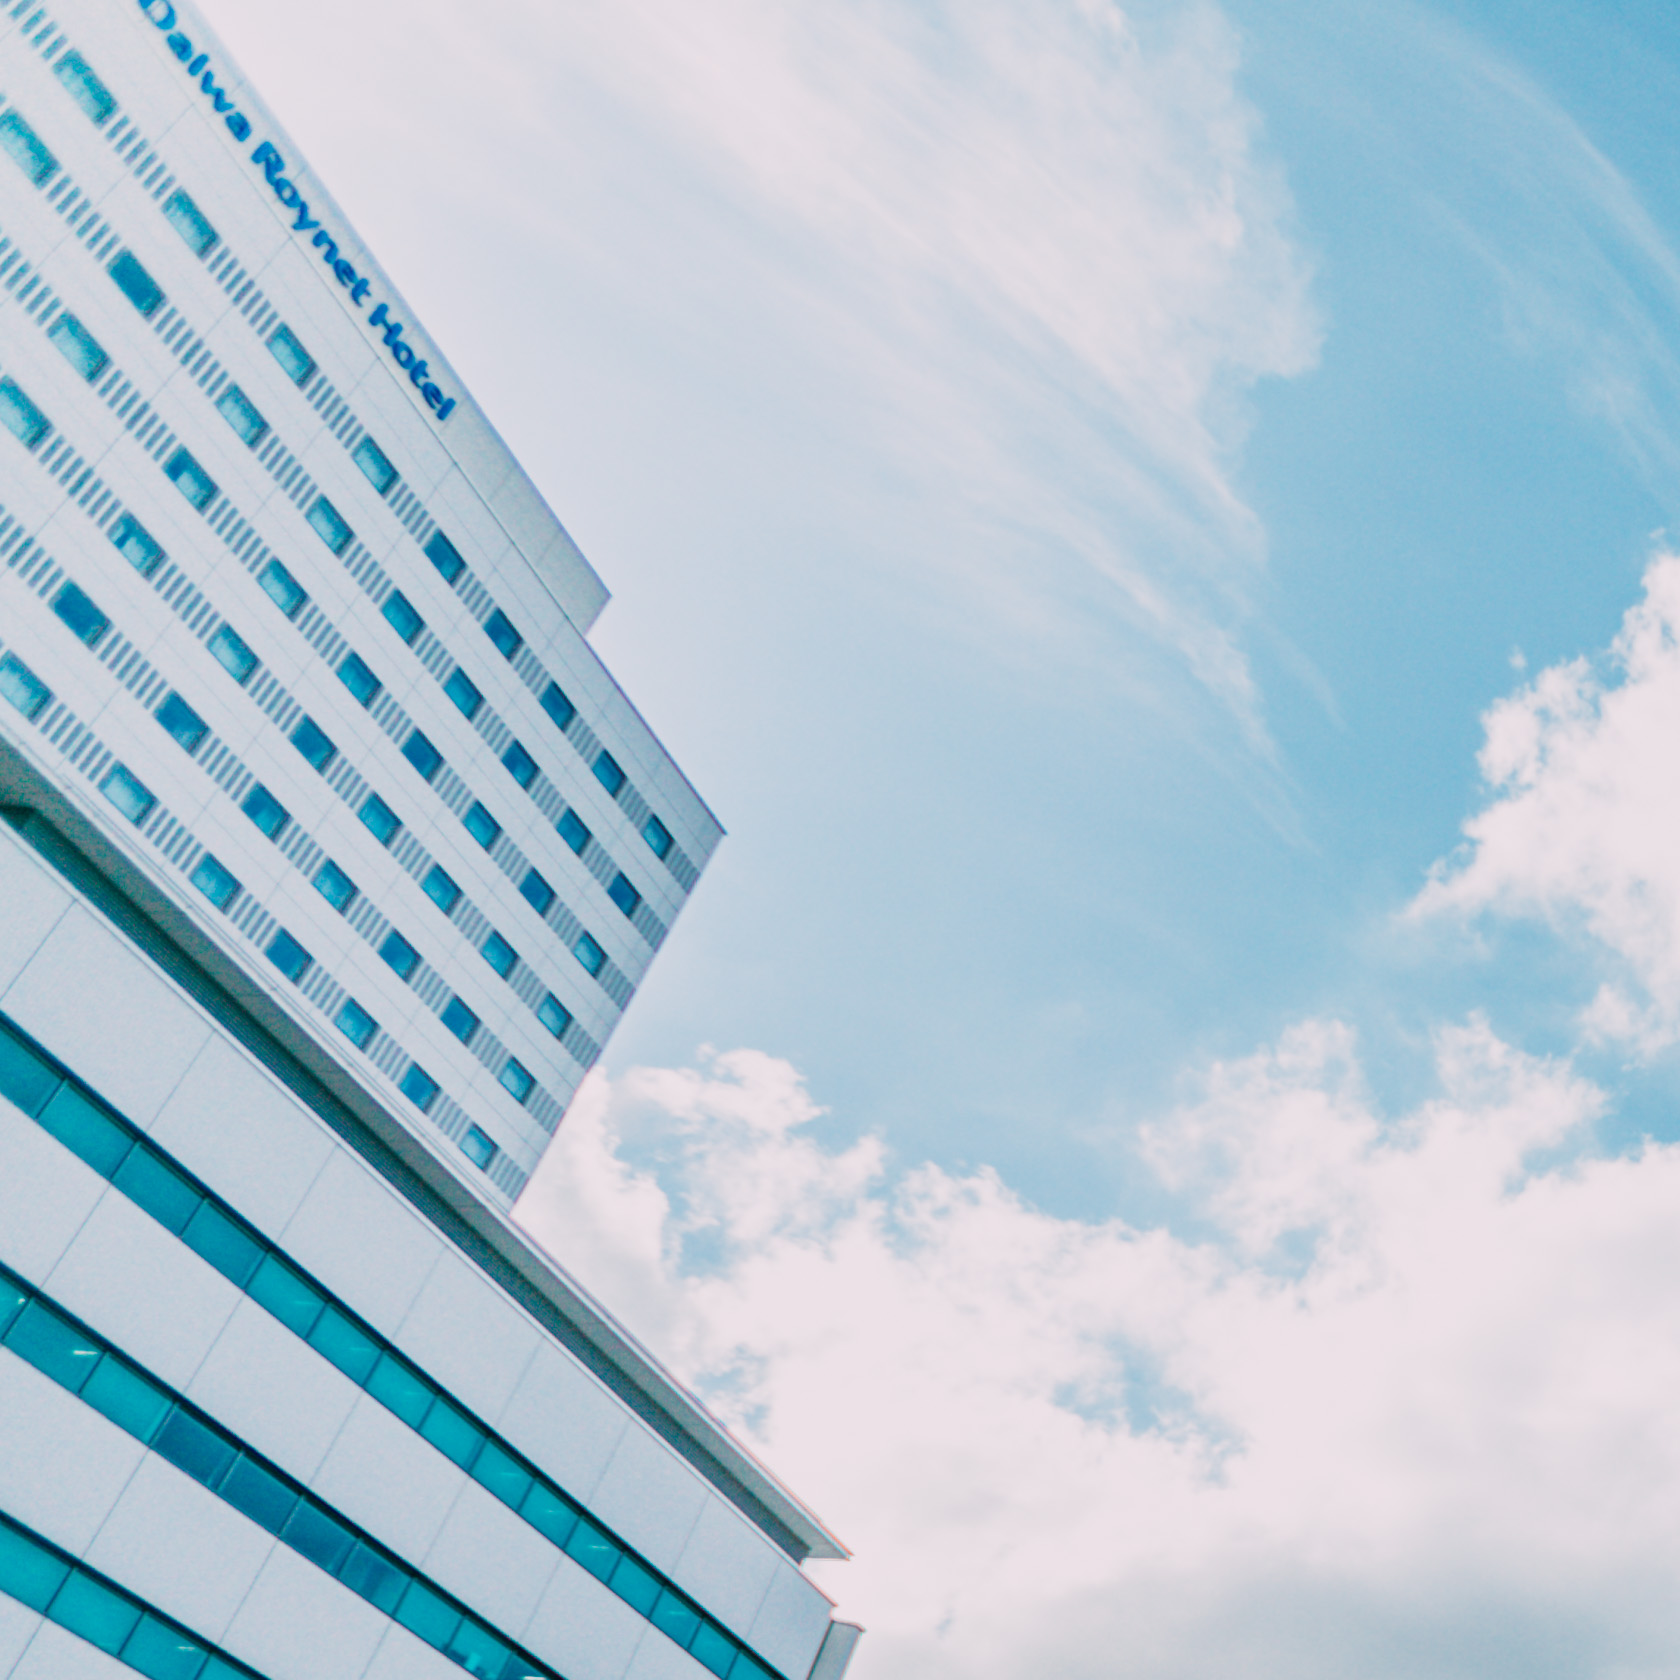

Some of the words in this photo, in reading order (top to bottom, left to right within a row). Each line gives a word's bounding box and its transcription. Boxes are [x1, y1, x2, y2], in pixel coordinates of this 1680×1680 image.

[138, 0, 252, 142] Daiwa
[251, 141, 372, 308] Roynet
[368, 303, 457, 421] Hotel
